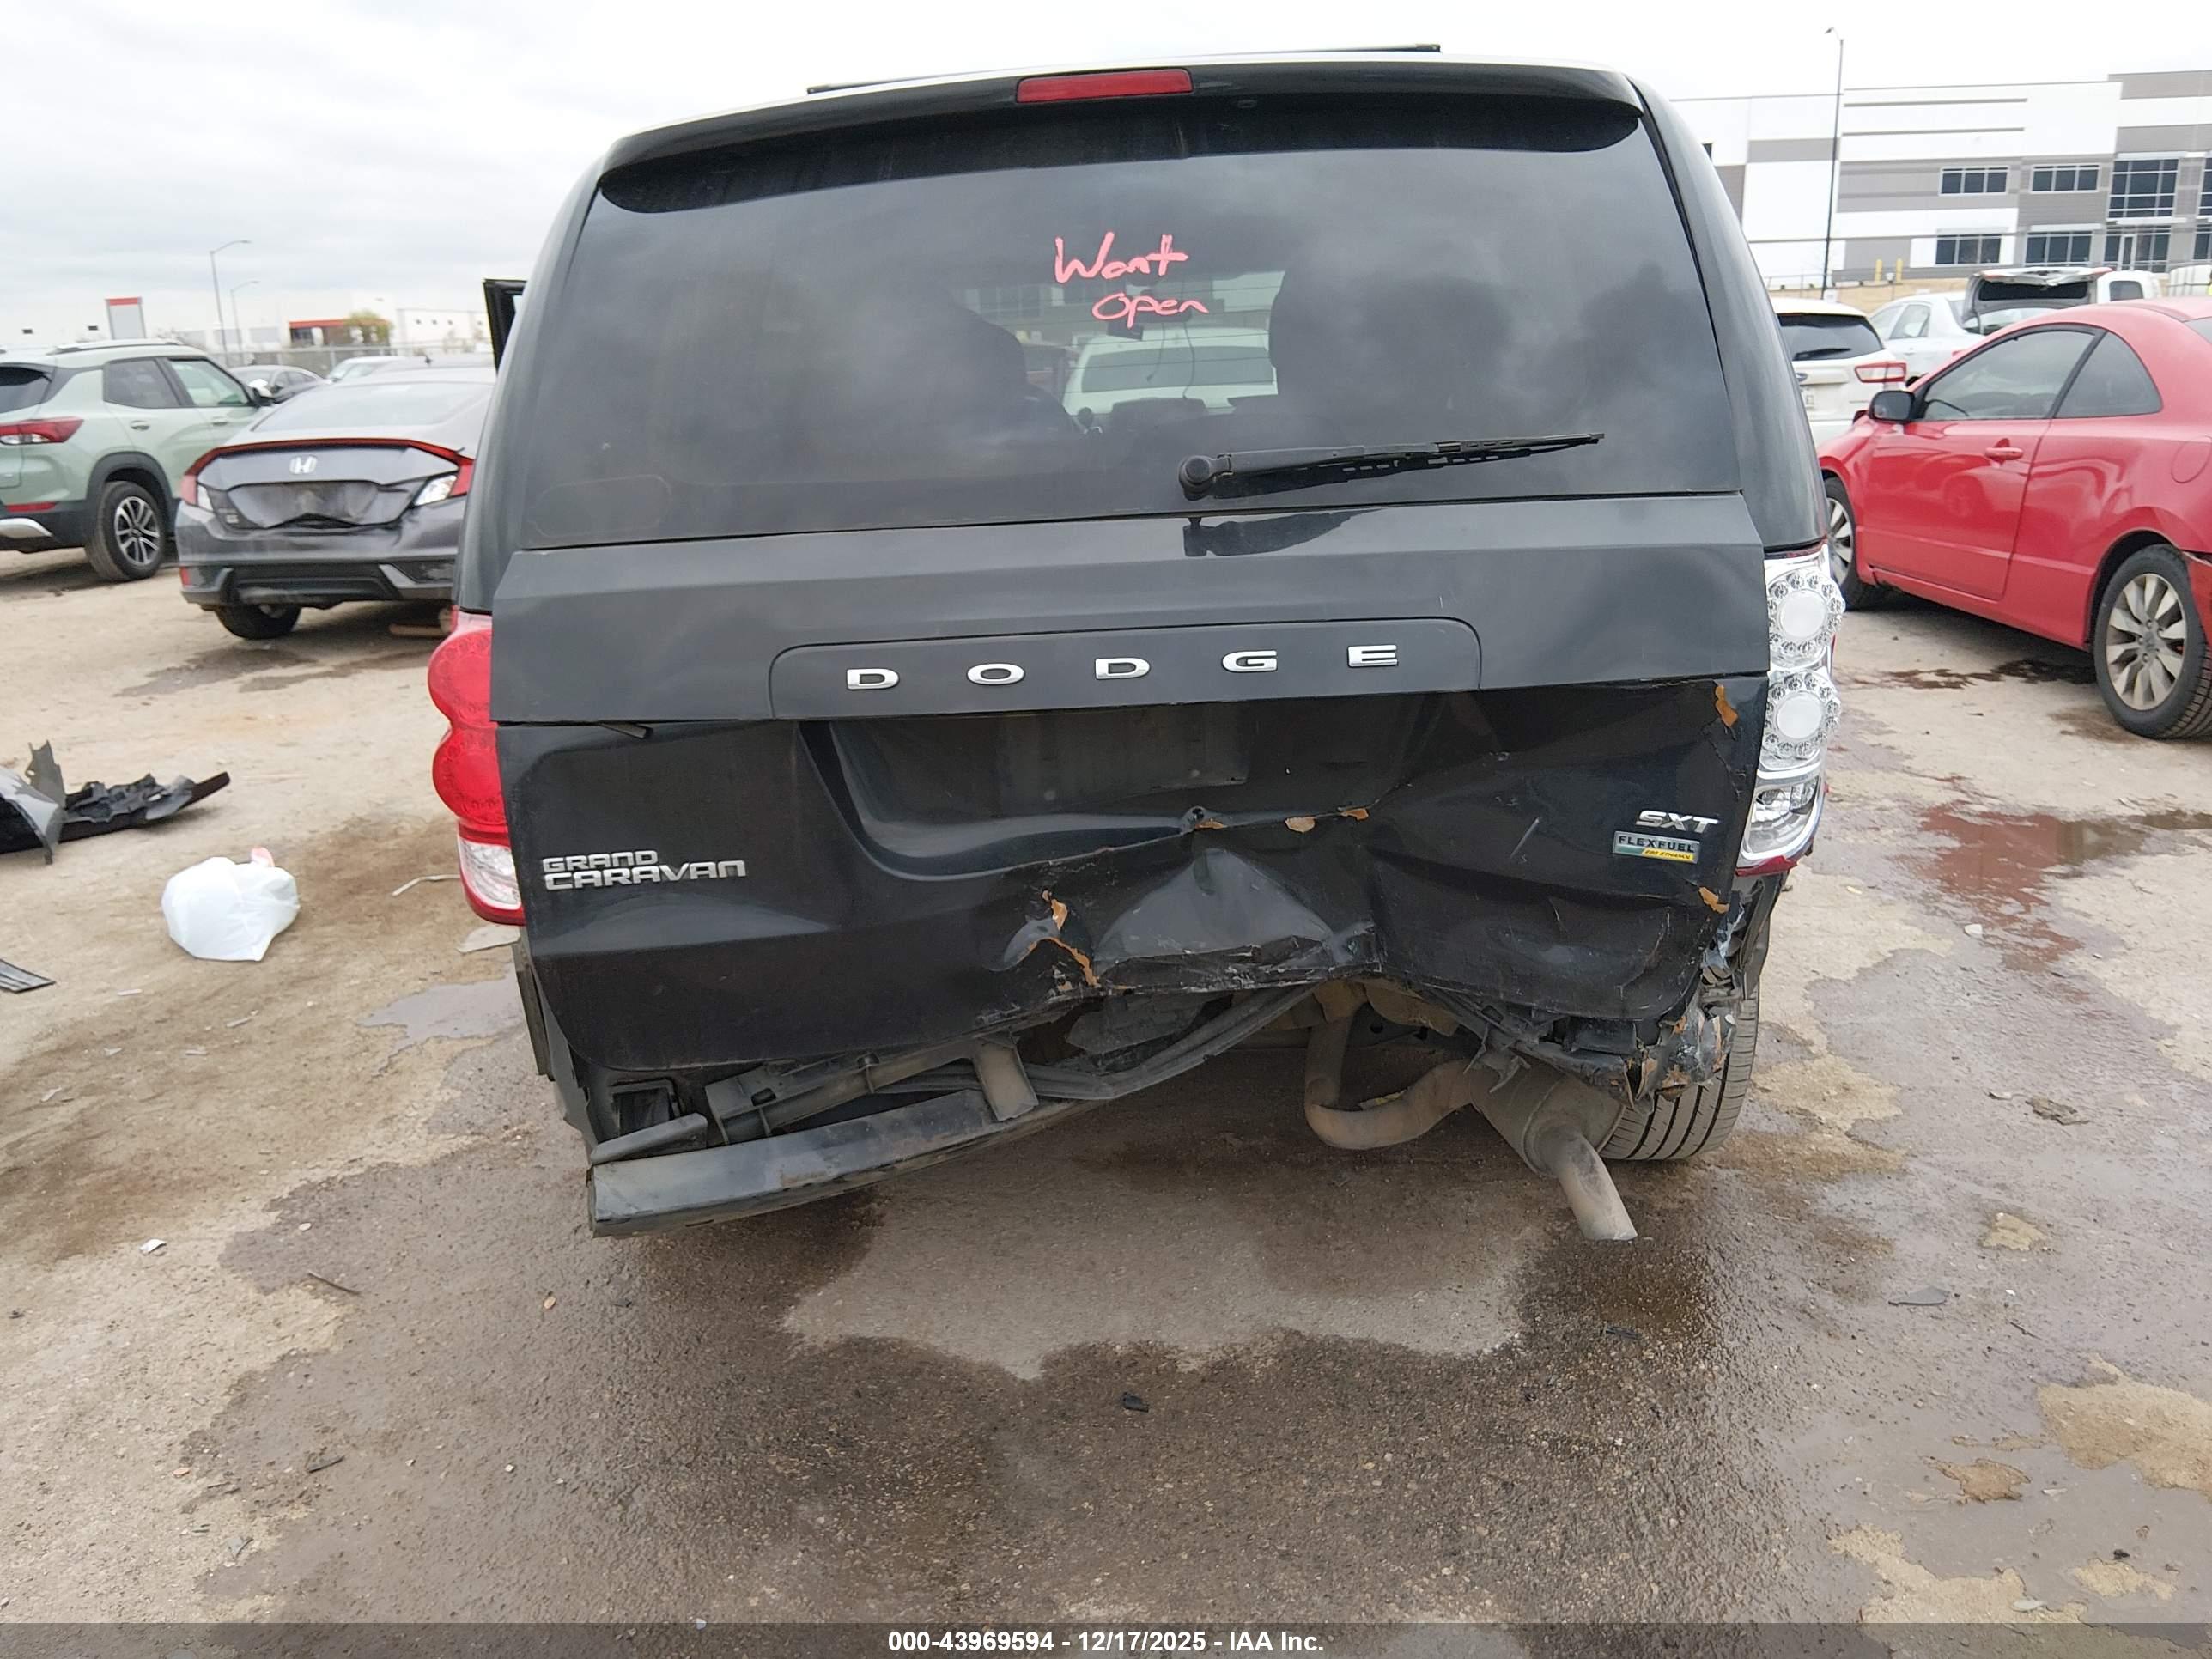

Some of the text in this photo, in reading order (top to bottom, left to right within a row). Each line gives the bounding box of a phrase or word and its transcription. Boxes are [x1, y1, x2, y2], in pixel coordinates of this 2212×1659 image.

[846, 644, 1399, 690] DODGE
[1635, 810, 1719, 834] SXT
[1618, 836, 1695, 853] FLEXFUEL
[542, 850, 659, 873] GRAND
[544, 860, 746, 890] CARAVAN
